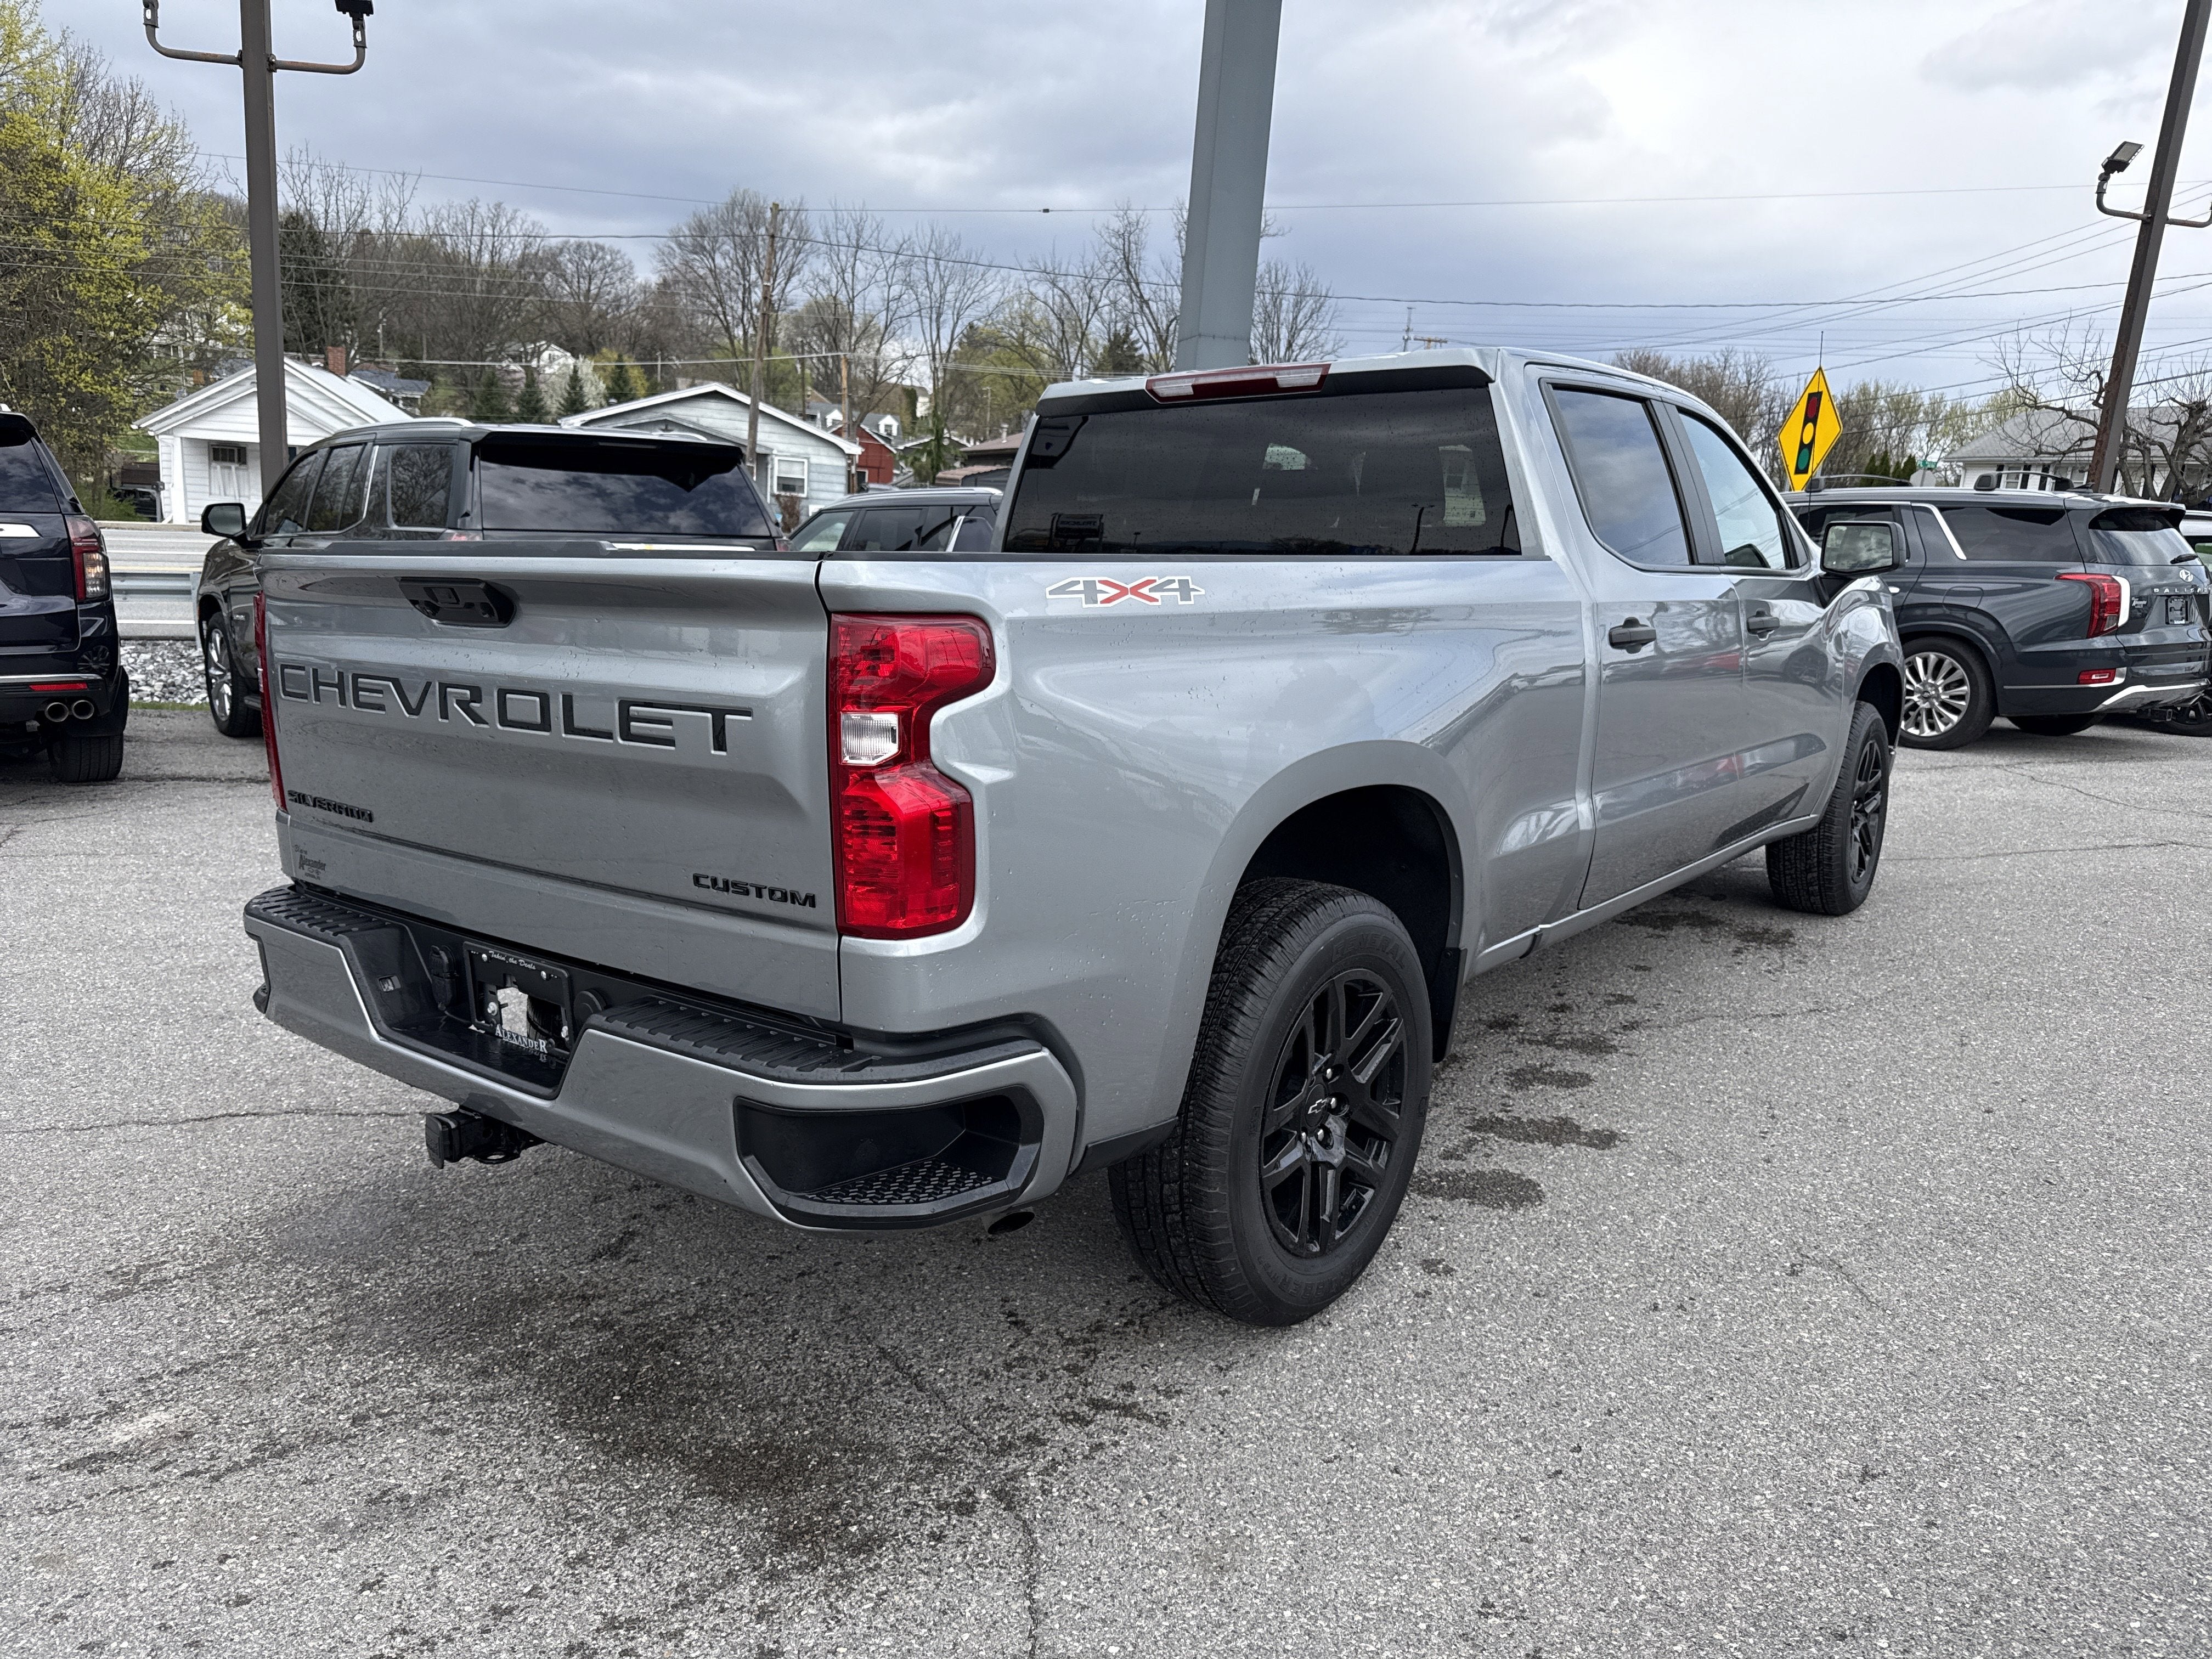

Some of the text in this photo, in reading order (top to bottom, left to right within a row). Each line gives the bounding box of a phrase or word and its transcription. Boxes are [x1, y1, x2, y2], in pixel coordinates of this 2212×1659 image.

[278, 664, 753, 755] CHEVROLET
[287, 789, 374, 823] SILVERADO
[692, 873, 816, 909] CUSTOM
[518, 959, 536, 969] Deals
[495, 1024, 548, 1053] ALEXANDER
